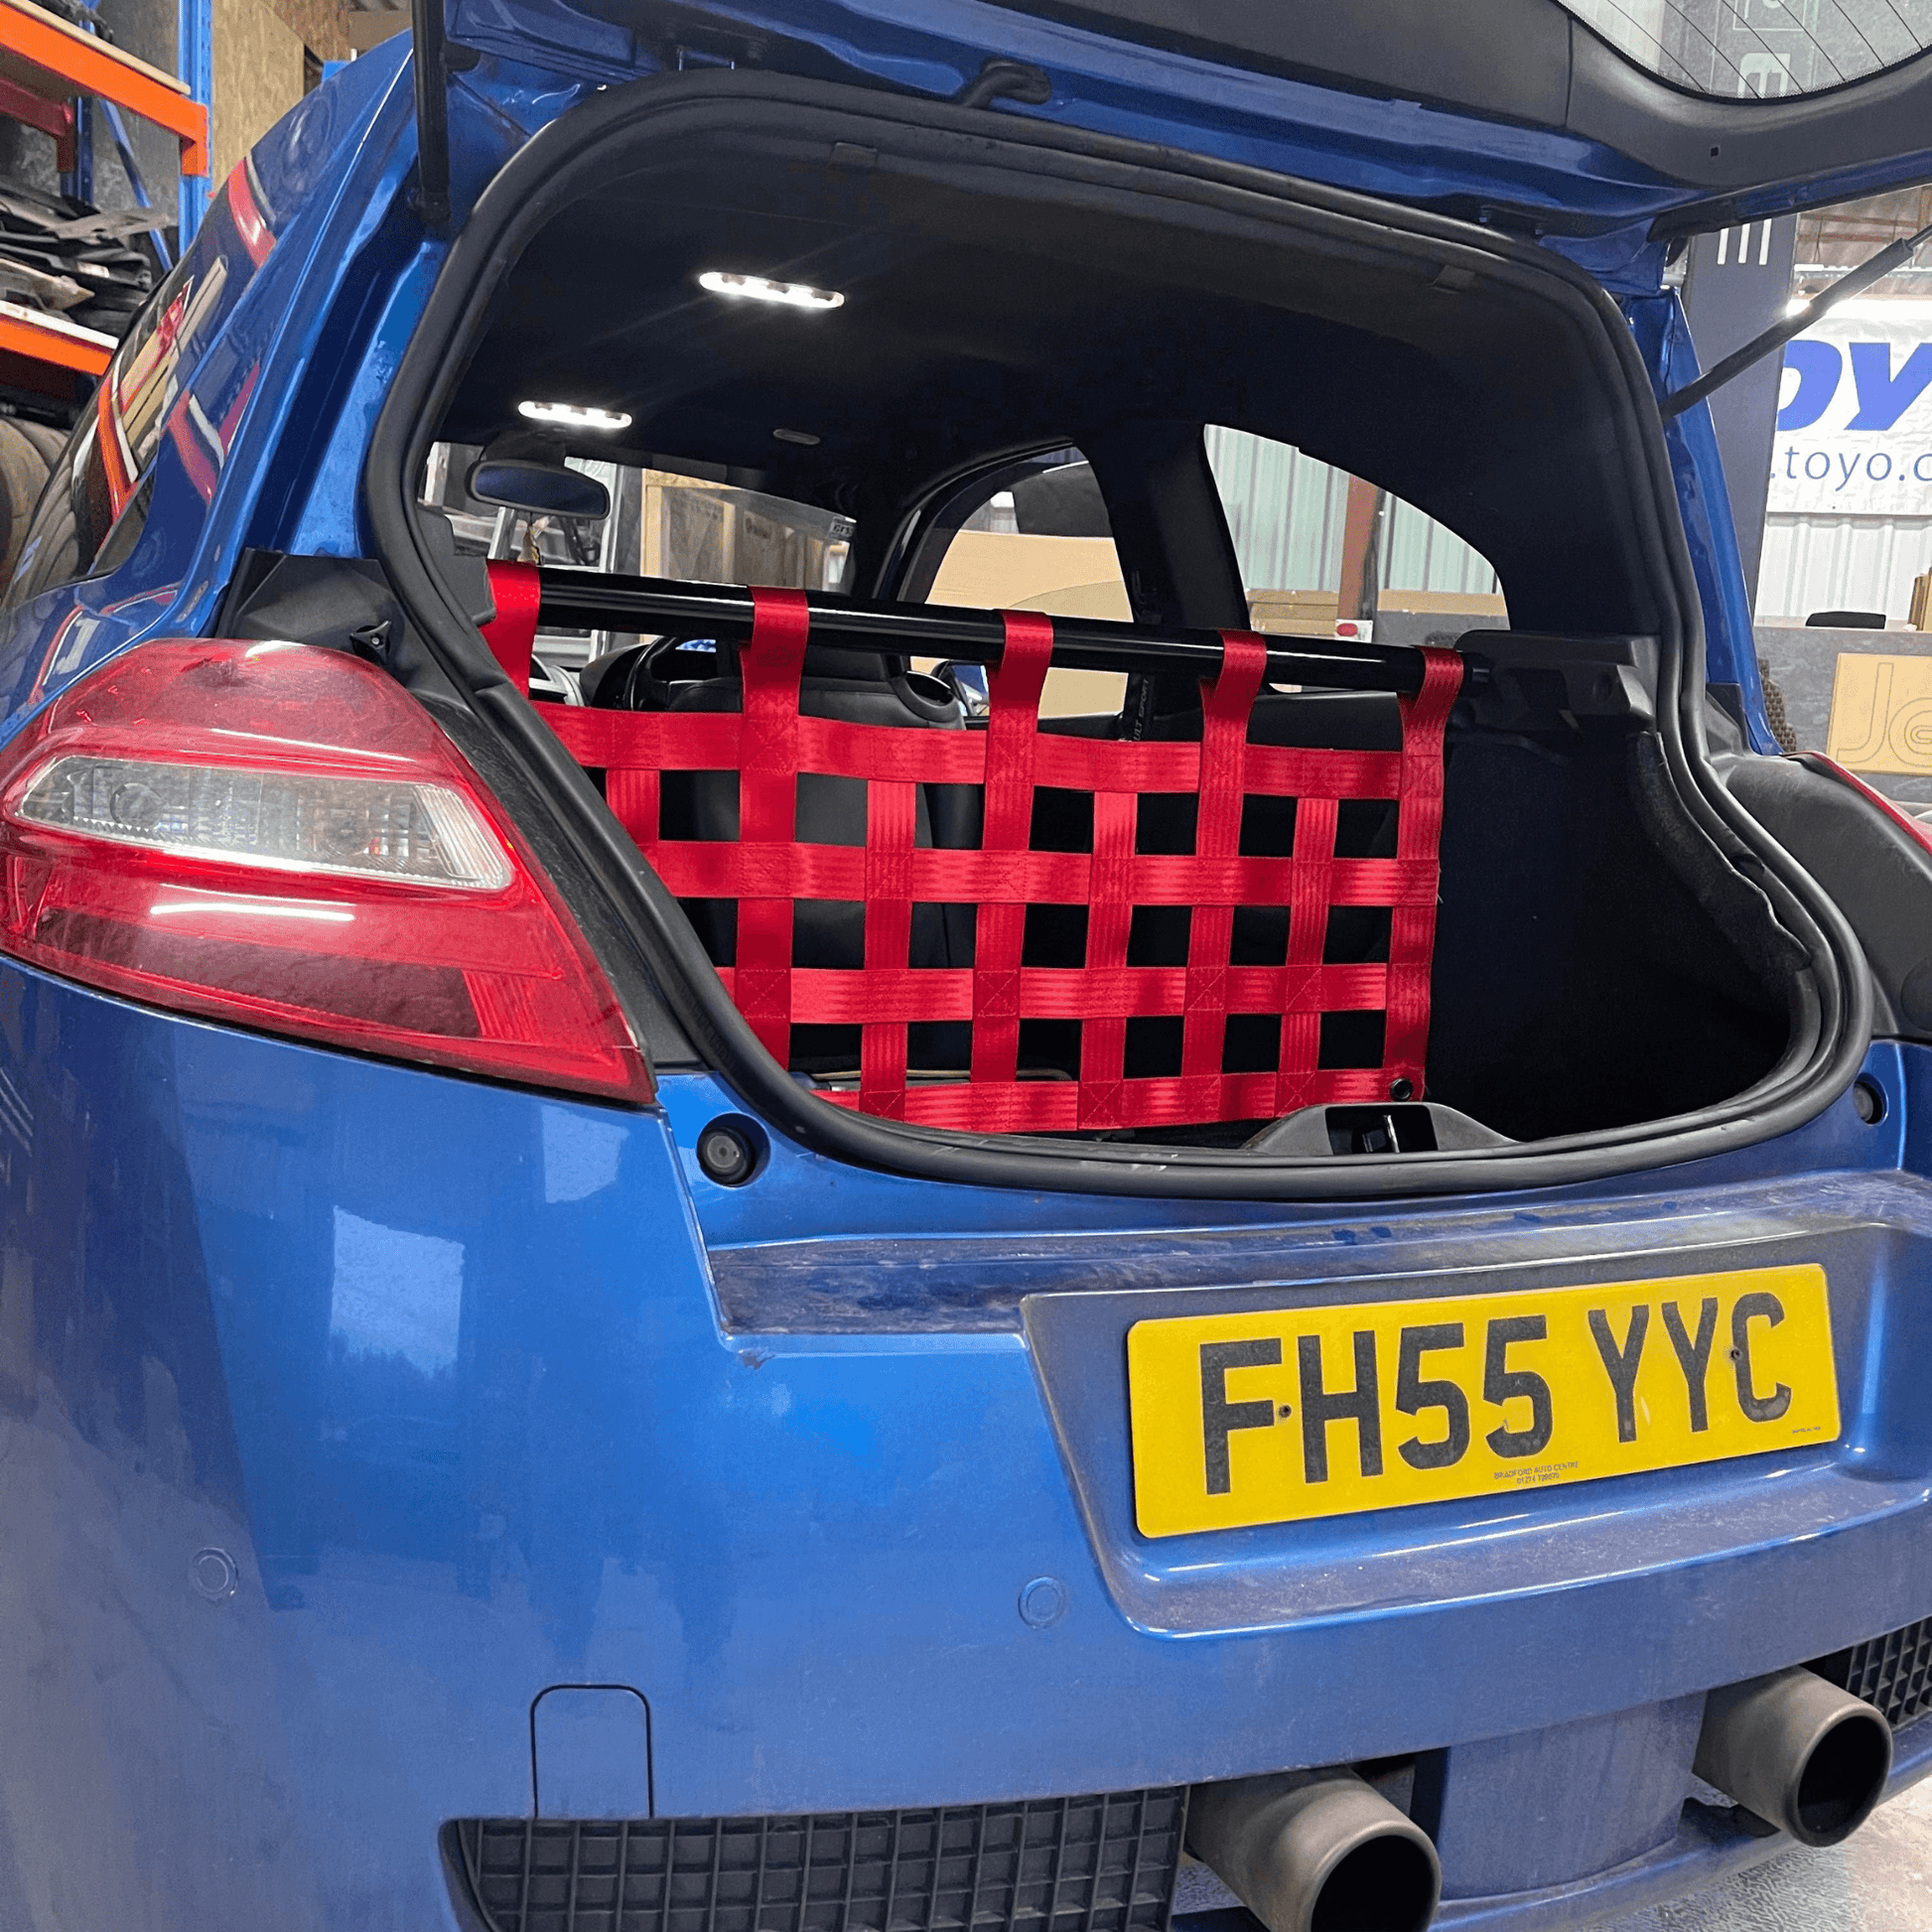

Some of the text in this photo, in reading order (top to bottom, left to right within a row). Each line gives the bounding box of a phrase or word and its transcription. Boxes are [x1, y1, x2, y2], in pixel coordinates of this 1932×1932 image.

[1200, 1294, 1790, 1494] FH55 YYC
[1494, 1468, 1532, 1479] BRADFORD
[1554, 1461, 1579, 1470] CENTRE
